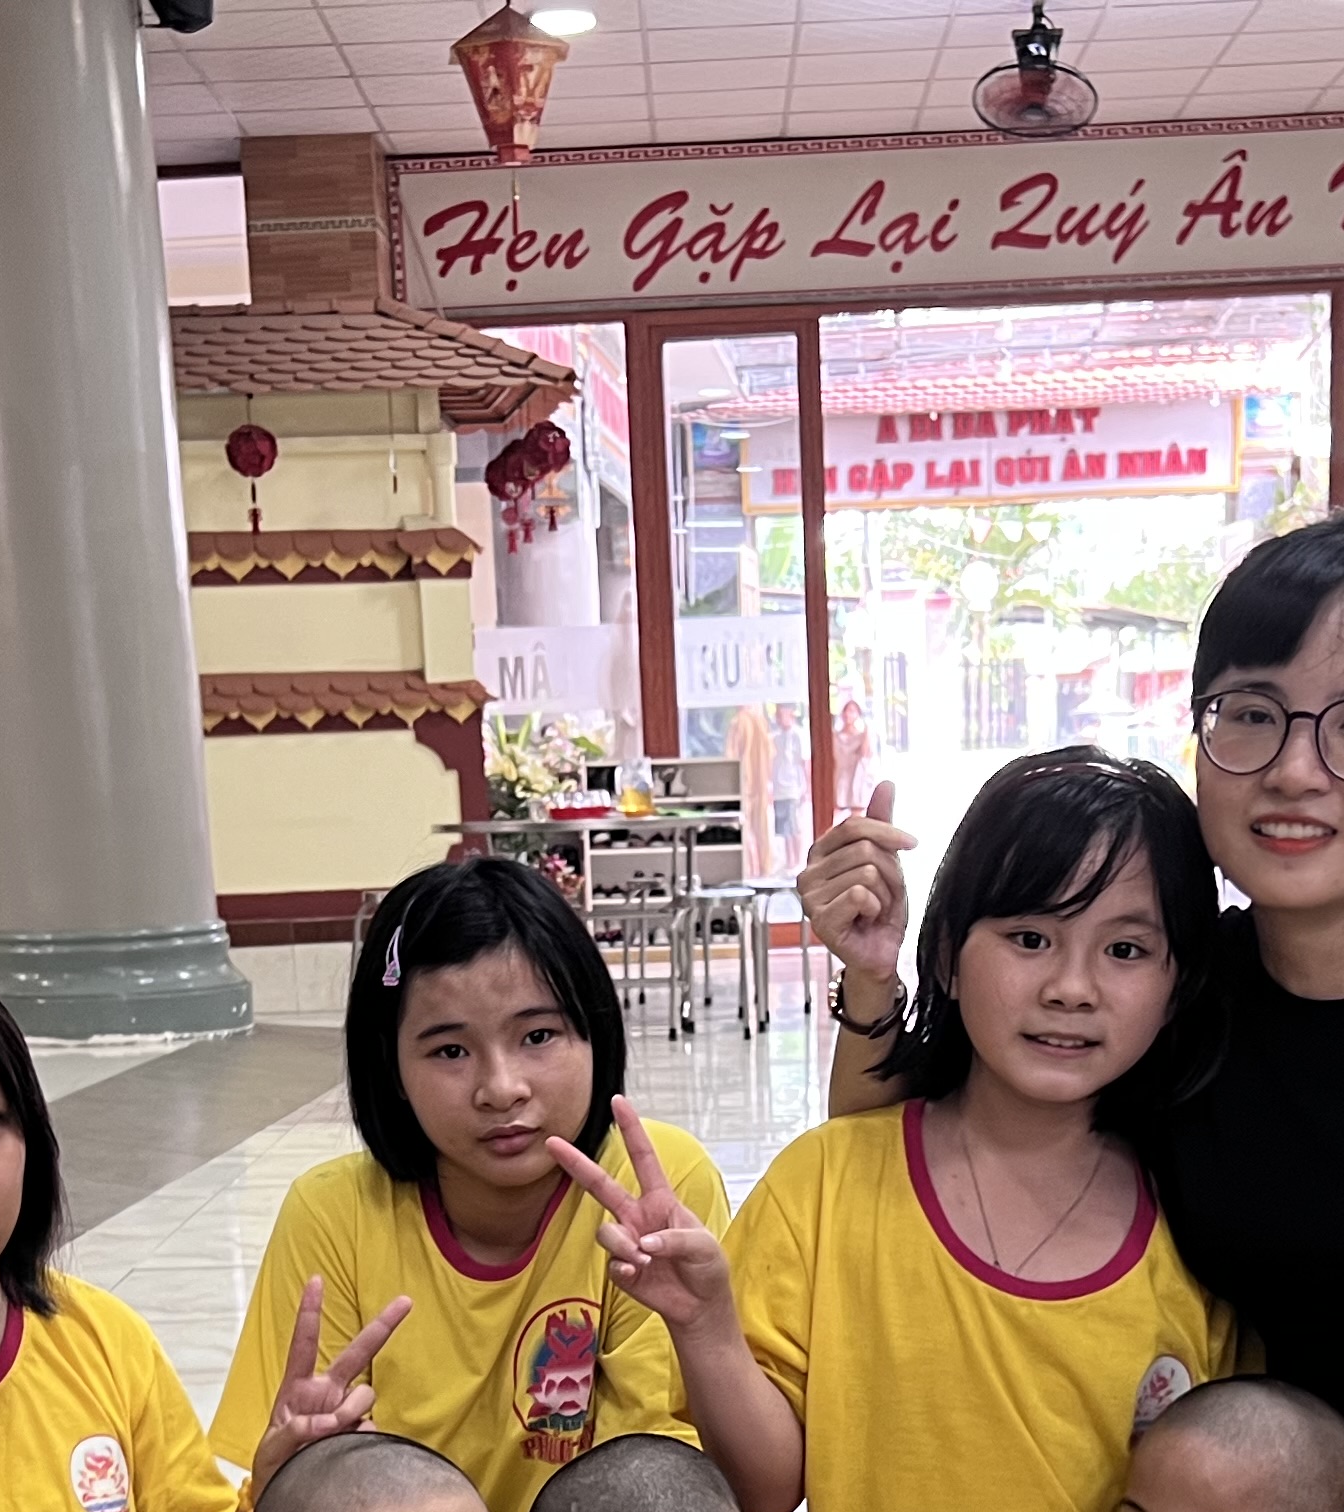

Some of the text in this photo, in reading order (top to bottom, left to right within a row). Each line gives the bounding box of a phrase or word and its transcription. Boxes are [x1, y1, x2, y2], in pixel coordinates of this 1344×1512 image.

[423, 200, 590, 292] Hẹn
[622, 189, 787, 292] Gặp
[809, 179, 960, 274] Lại
[990, 172, 1151, 264] Quý
[1175, 149, 1293, 246] Ân
[924, 458, 982, 496] LẠI
[1060, 448, 1108, 482] ÂN
[1115, 441, 1209, 479] NHÂN
